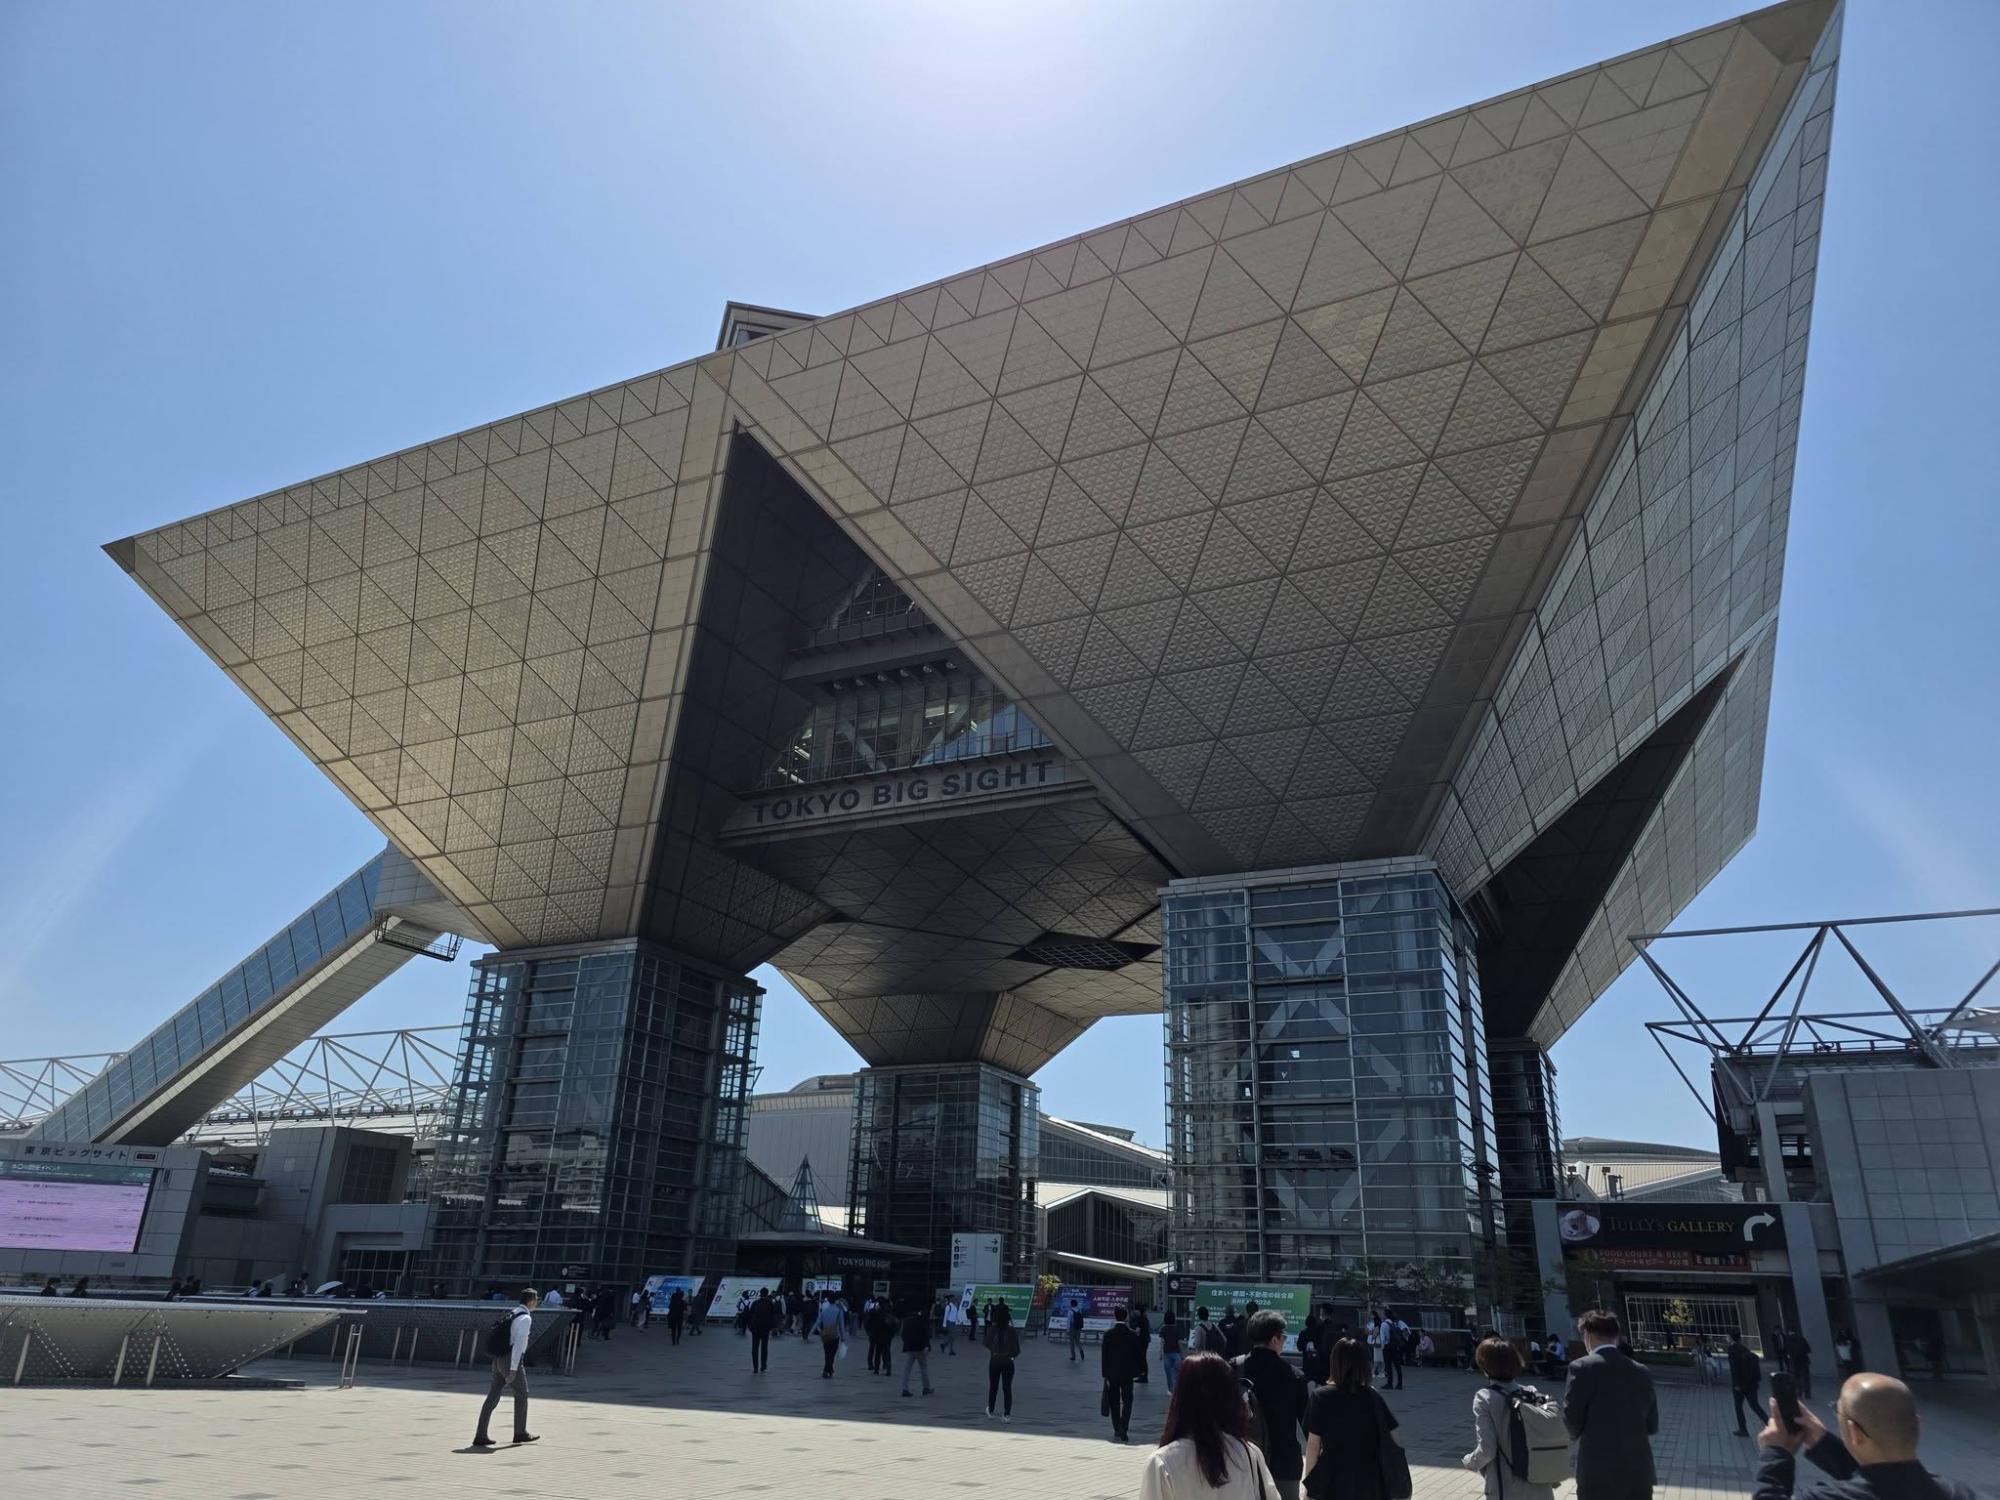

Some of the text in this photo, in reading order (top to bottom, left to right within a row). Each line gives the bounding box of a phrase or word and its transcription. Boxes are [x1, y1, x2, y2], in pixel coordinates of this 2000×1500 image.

[753, 760, 1054, 824] TOKYO BIG SIGHT
[24, 1145, 127, 1160] 東京ビッグサイト
[1667, 1220, 1735, 1233] GALLERY
[837, 1256, 864, 1267] TOKYO
